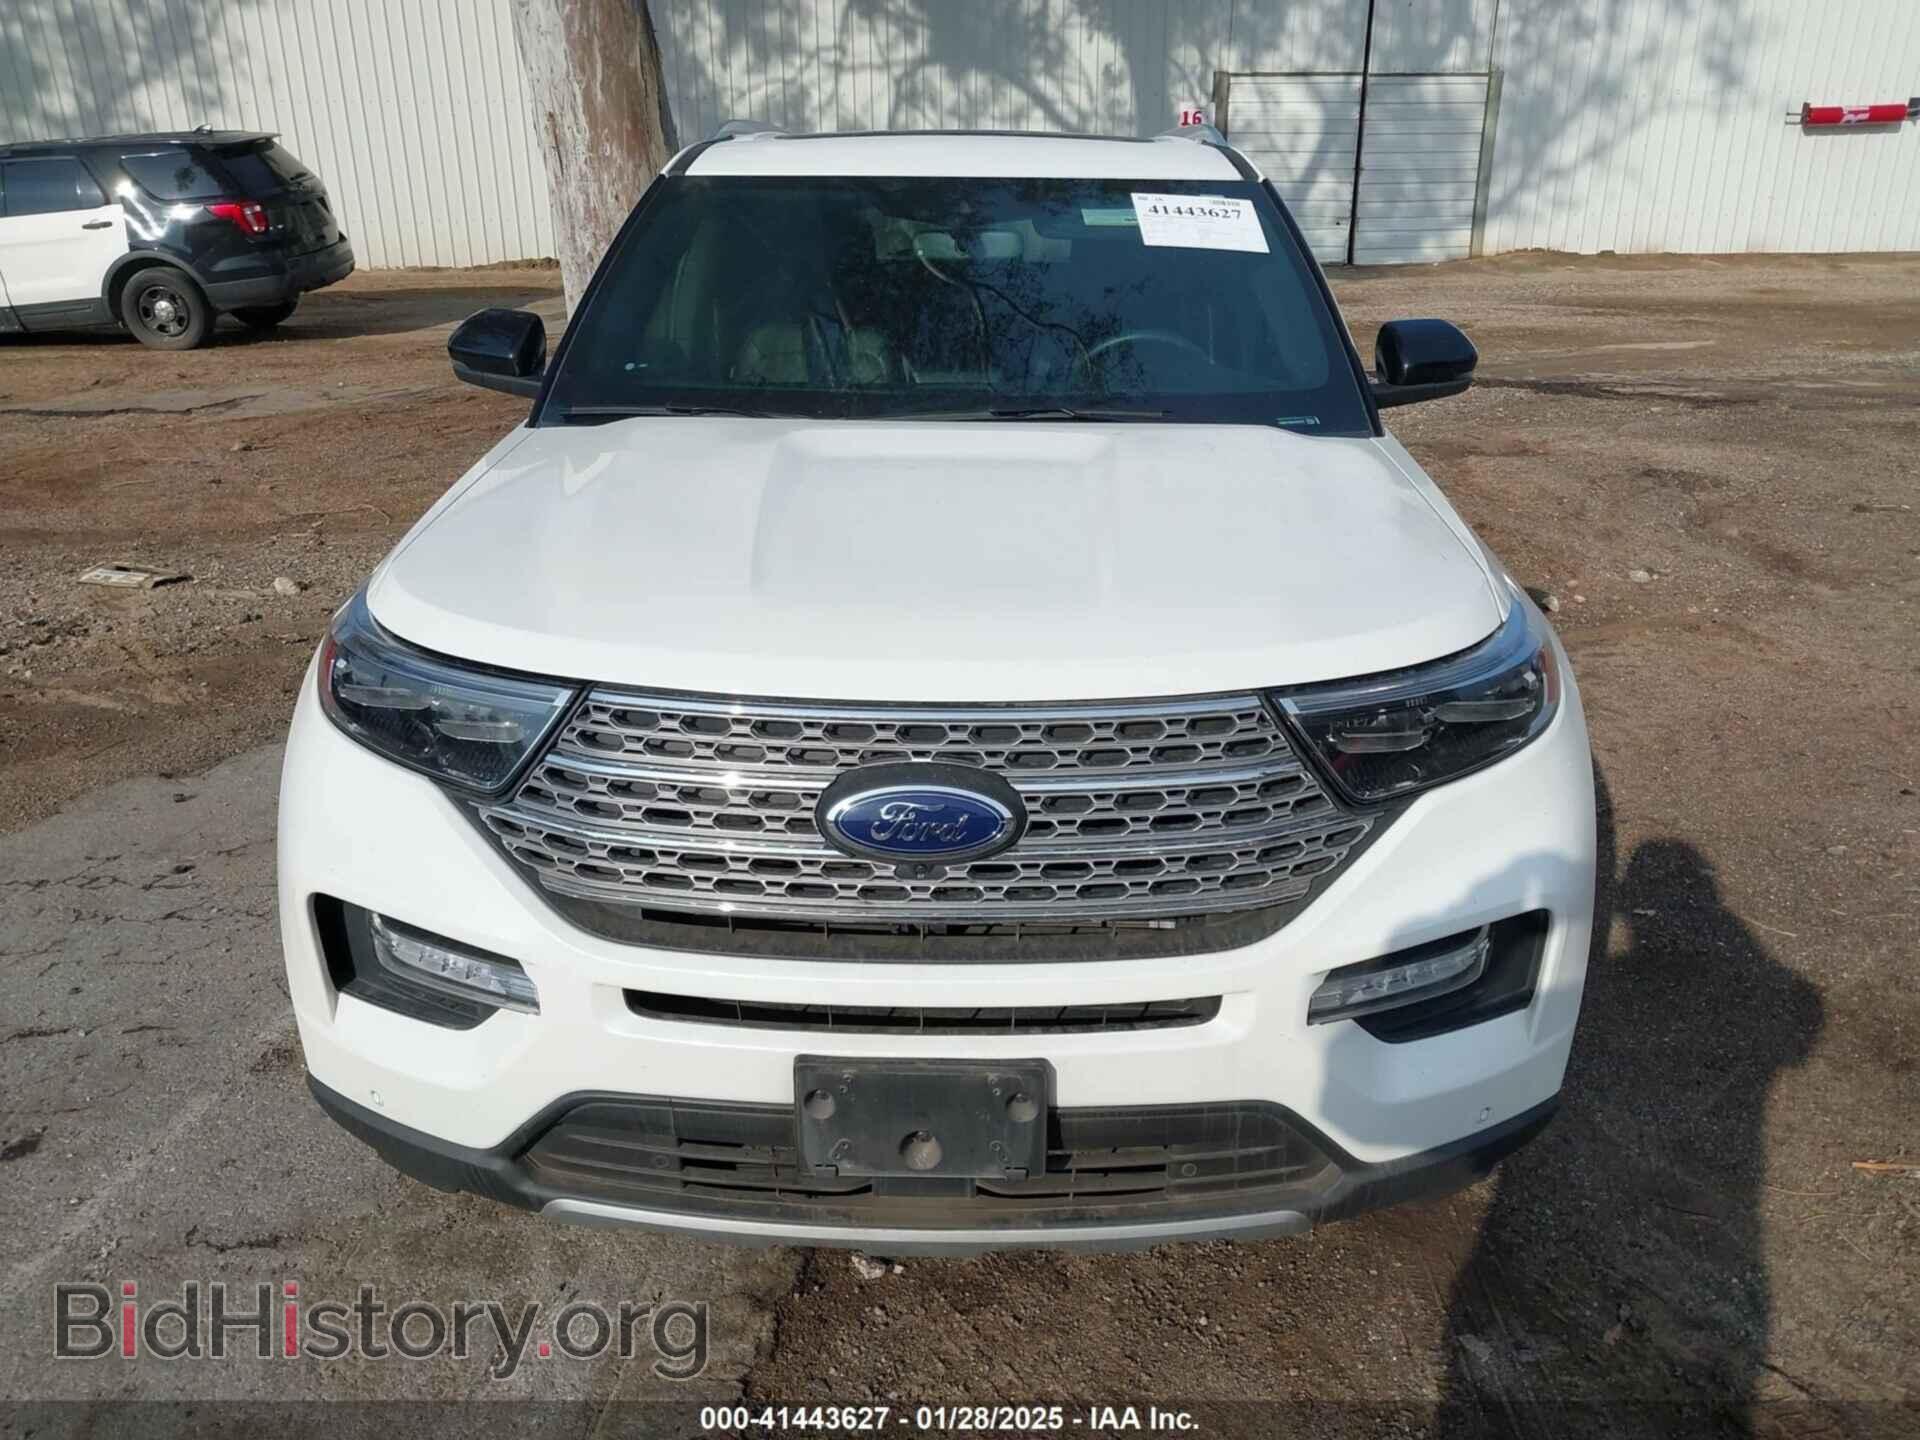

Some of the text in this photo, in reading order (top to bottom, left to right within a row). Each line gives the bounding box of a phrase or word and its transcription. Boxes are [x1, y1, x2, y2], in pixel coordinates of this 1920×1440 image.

[1181, 111, 1203, 126] 16
[1147, 204, 1241, 220] 41443627
[870, 801, 968, 842] Ford
